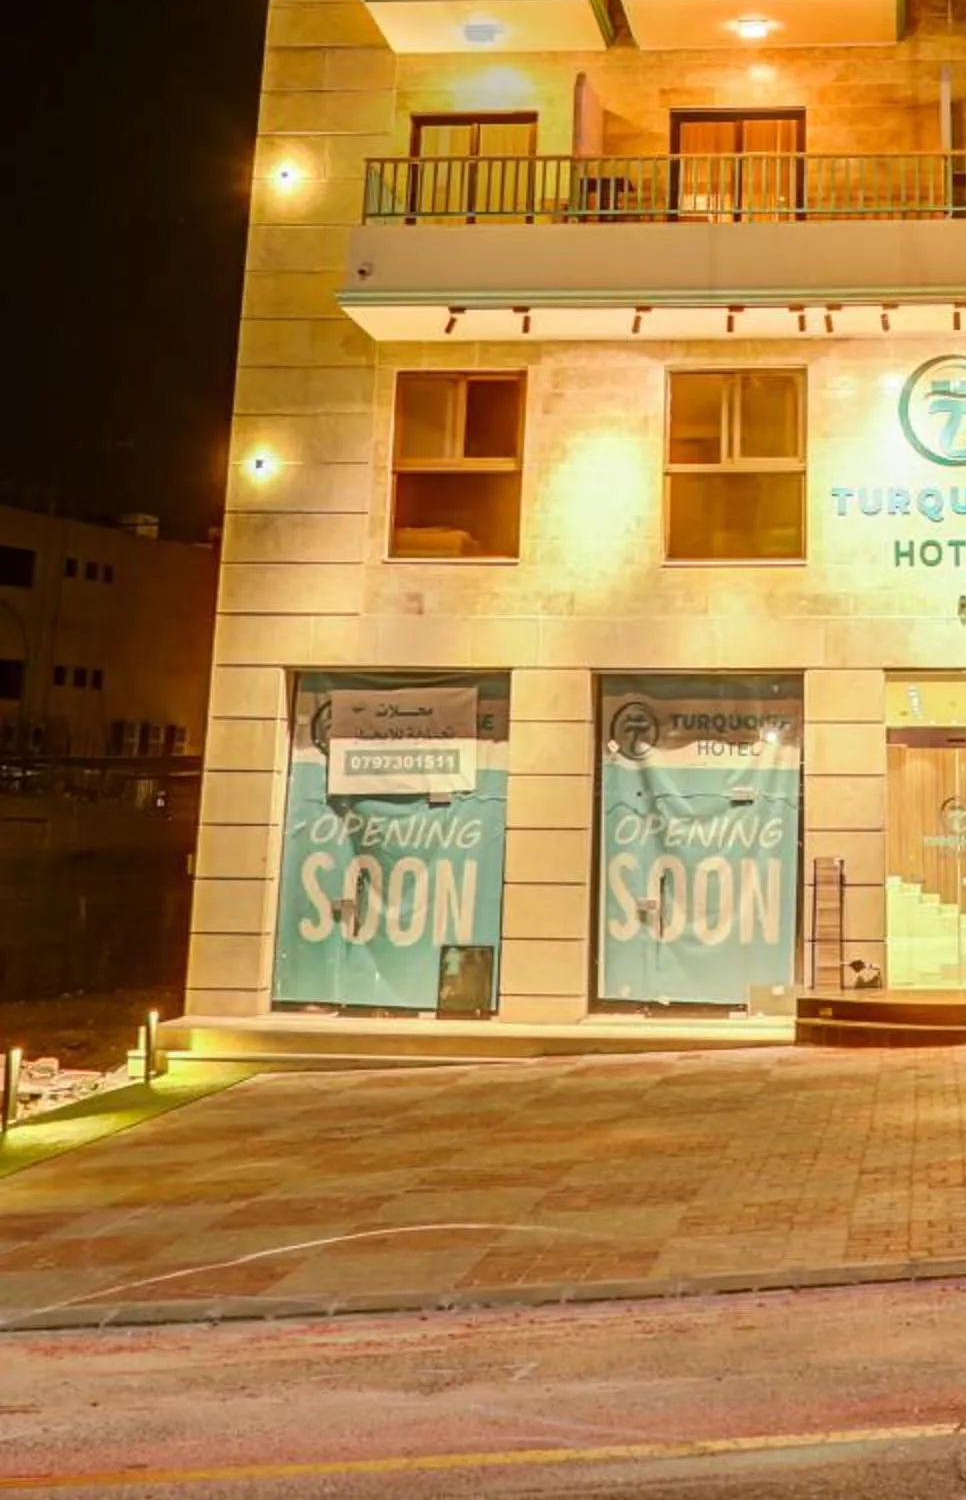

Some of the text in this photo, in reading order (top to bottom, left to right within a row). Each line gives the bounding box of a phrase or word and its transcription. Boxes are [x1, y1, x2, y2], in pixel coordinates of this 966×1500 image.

[697, 741, 762, 757] HOTEL
[310, 812, 483, 851] OPENING
[614, 813, 783, 852] OPENING
[299, 851, 478, 946] SOON
[608, 852, 782, 946] SOON
